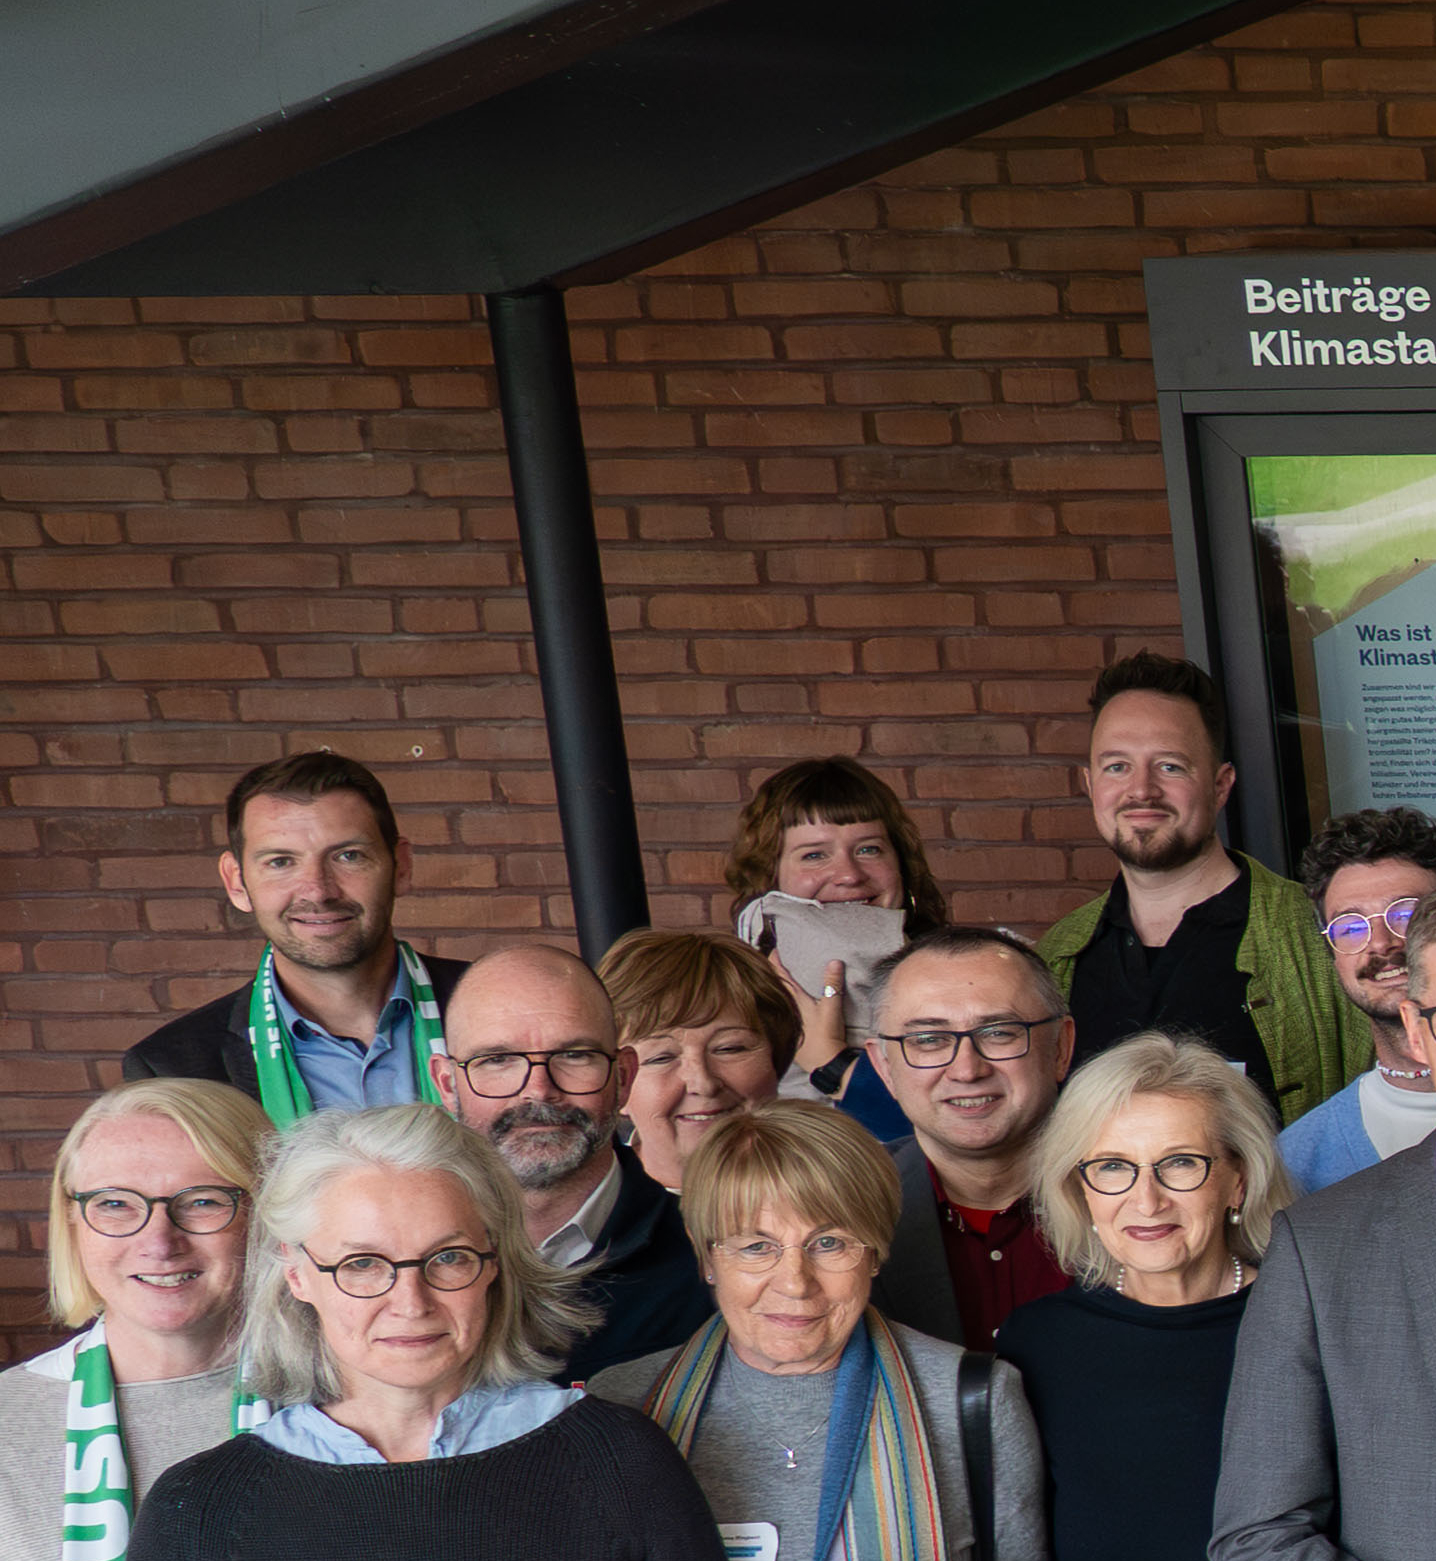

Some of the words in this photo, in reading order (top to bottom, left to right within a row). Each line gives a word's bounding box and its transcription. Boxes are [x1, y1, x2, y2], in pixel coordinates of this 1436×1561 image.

[1245, 277, 1431, 323] Beiträge
[1356, 625, 1401, 642] Was
[1407, 624, 1432, 641] ist
